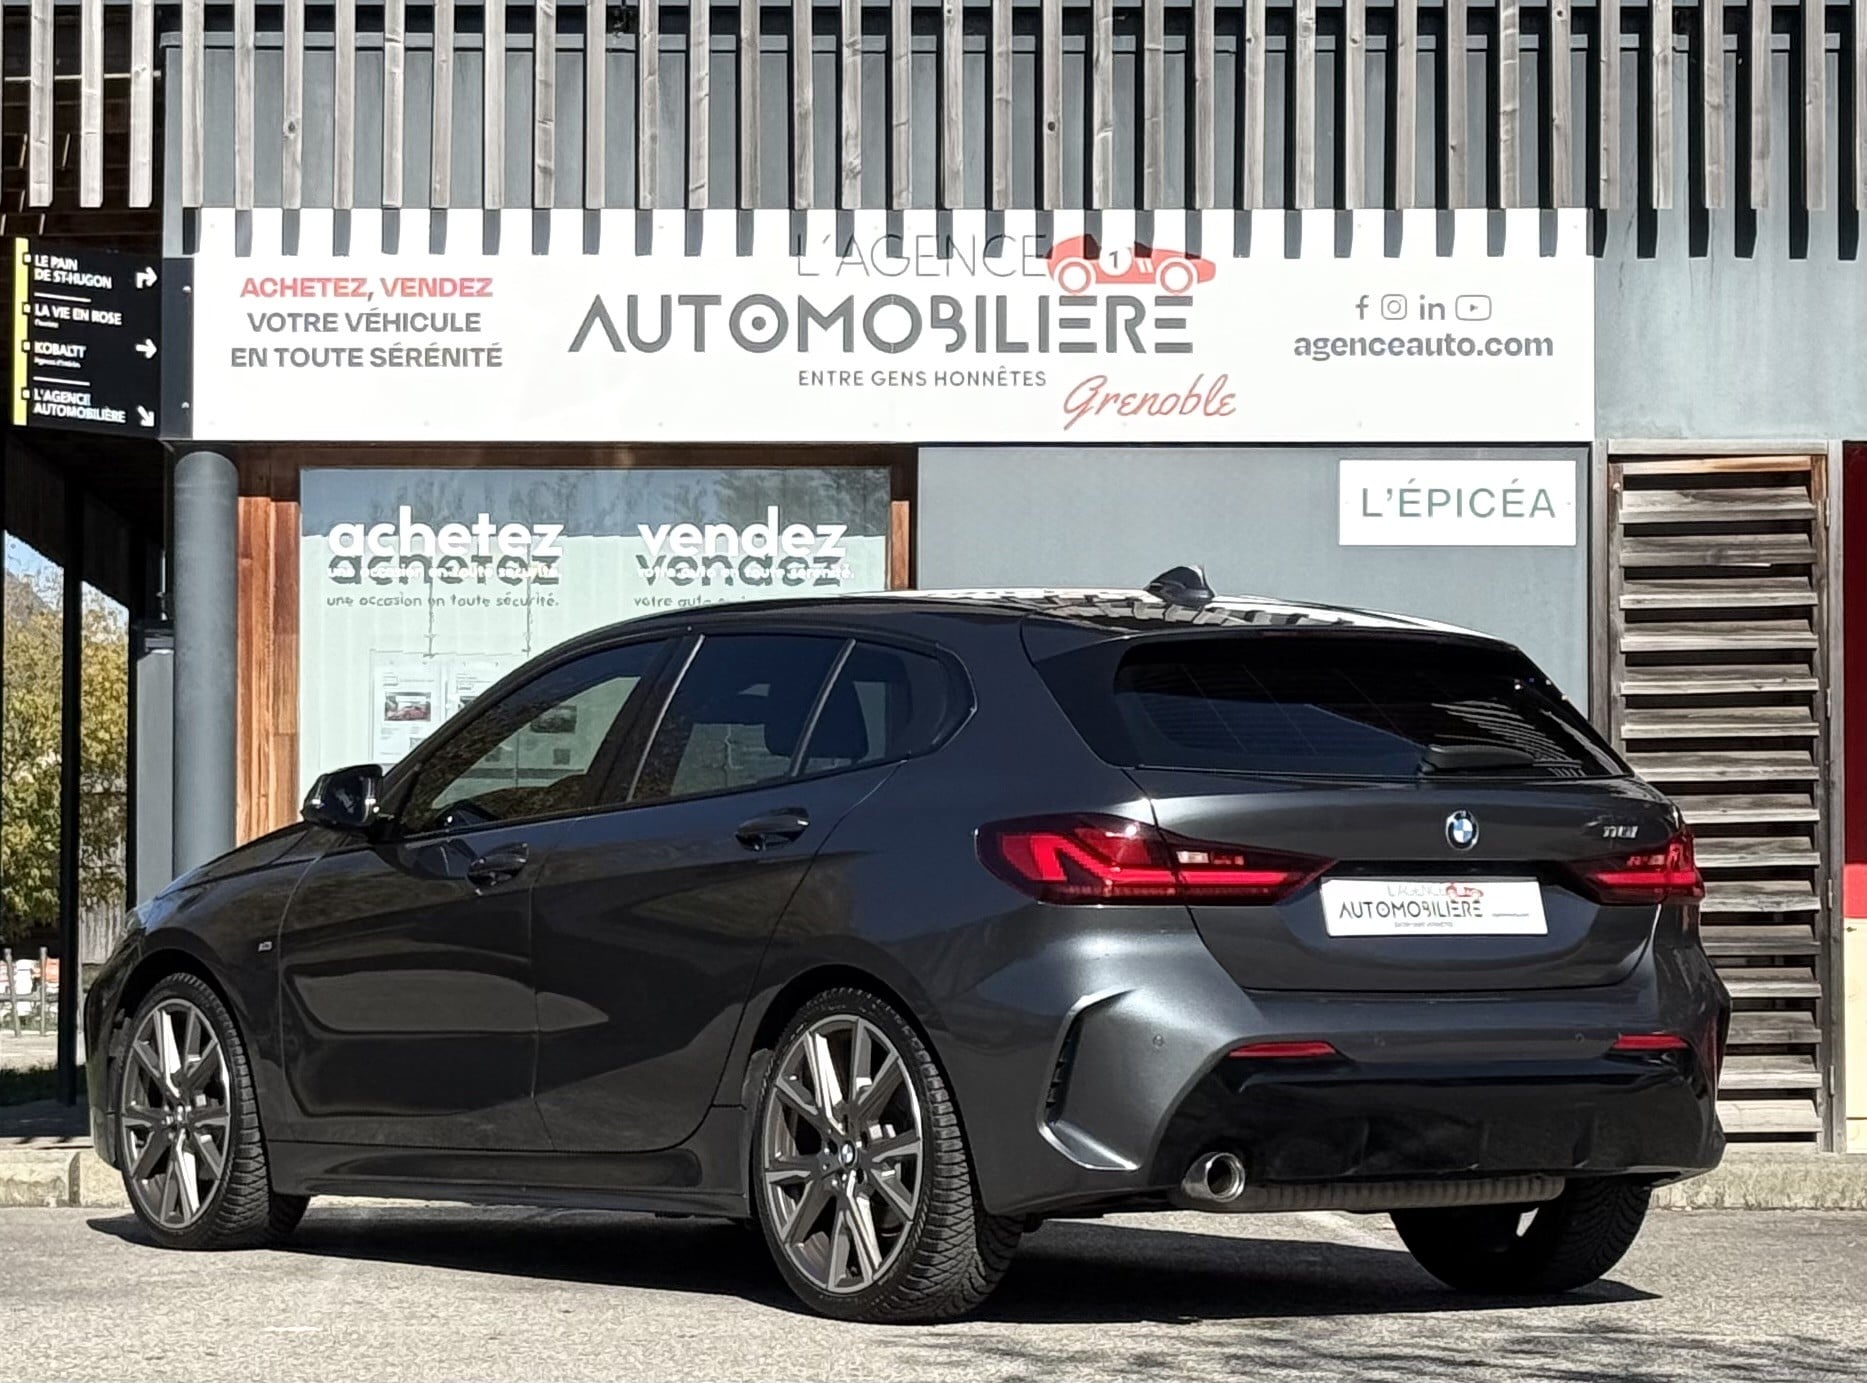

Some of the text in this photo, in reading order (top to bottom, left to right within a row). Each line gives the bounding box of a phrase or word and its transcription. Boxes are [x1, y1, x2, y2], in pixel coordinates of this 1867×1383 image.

[34, 254, 78, 271] LE PAIN
[797, 233, 1047, 277] L'AGENCE
[1109, 251, 1118, 268] 1
[34, 269, 52, 282] DE
[240, 277, 493, 301] ACHETEZ, VENDEZ
[34, 303, 122, 325] LA VIE EN ROSE
[247, 307, 482, 333] VOTRE VÉHICULE
[231, 342, 503, 367] EN TOUTE SÉRÉNITÉ
[1294, 333, 1554, 362] agenceauto.com
[799, 366, 1046, 386] ENTRE GENS HONNÊTES
[1064, 374, 1236, 430] Grenoble
[328, 505, 565, 557] achetez
[637, 505, 849, 557] vendez
